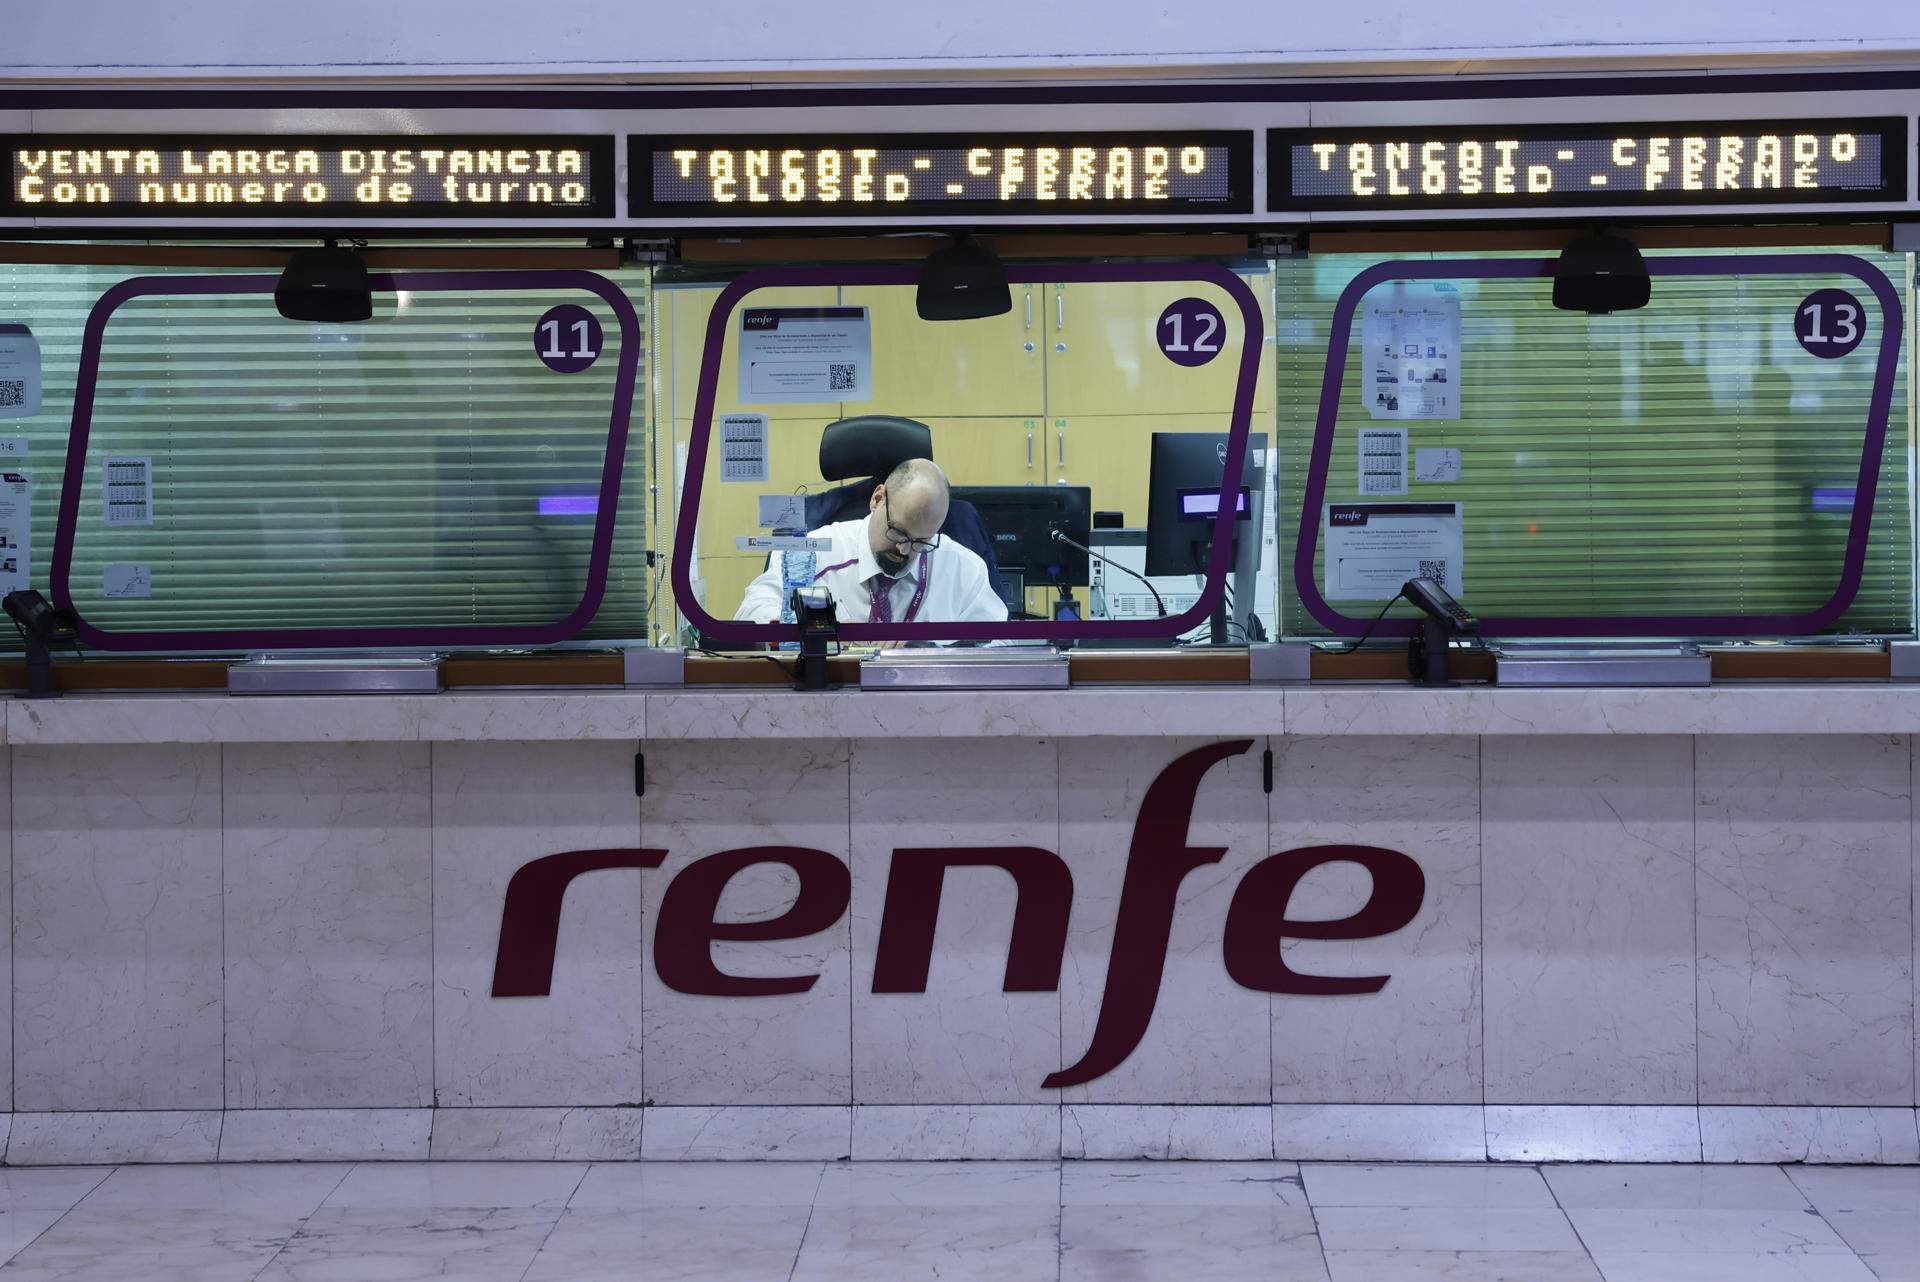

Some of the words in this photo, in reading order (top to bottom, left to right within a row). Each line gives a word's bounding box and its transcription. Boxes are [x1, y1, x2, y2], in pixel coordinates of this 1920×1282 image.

[19, 150, 160, 174] VENTA
[182, 150, 319, 174] LARGA
[341, 149, 582, 174] DISTANCIA
[673, 149, 877, 177] TANCAT
[967, 146, 1205, 176] CERRADO
[1312, 140, 1519, 170] TANCAT
[1612, 133, 1856, 166] CERRADO
[20, 175, 110, 203] Con
[140, 181, 327, 203] numero
[356, 175, 413, 203] de
[442, 176, 586, 203] turno
[713, 173, 909, 203] CLOSED
[1352, 165, 1552, 196] CLOSED
[747, 315, 772, 325] renfe
[1164, 313, 1218, 352] 12
[1803, 303, 1858, 344] 13
[541, 319, 596, 358] 11
[1334, 511, 1362, 522] renfe
[805, 540, 818, 549] 1-6
[491, 739, 1426, 1089] renfe
